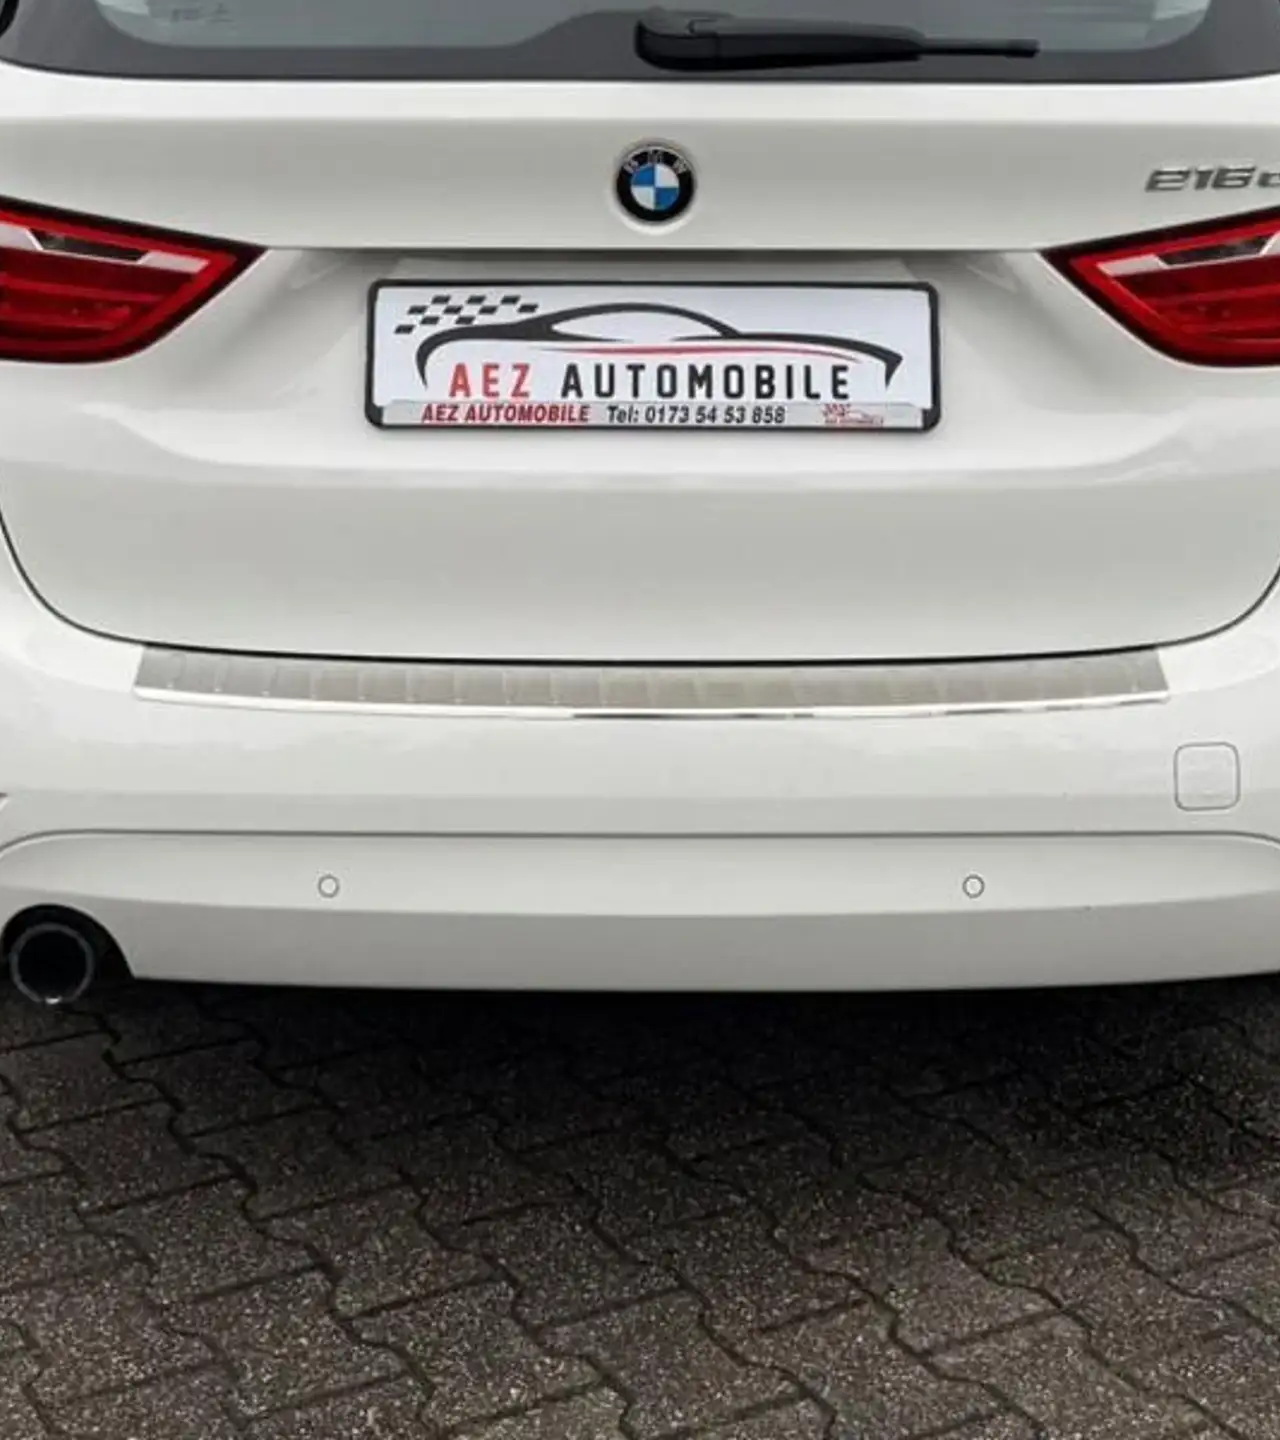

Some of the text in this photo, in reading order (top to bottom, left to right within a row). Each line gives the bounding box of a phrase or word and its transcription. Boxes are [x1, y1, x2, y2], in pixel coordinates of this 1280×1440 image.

[448, 363, 850, 400] AEZ AUTOMOBILE
[422, 405, 460, 422] AEZ
[464, 406, 591, 423] AUTOMOBILE
[607, 406, 639, 424] Tel:
[645, 406, 689, 424] 0173
[695, 406, 718, 424] 54
[723, 406, 746, 424] 53
